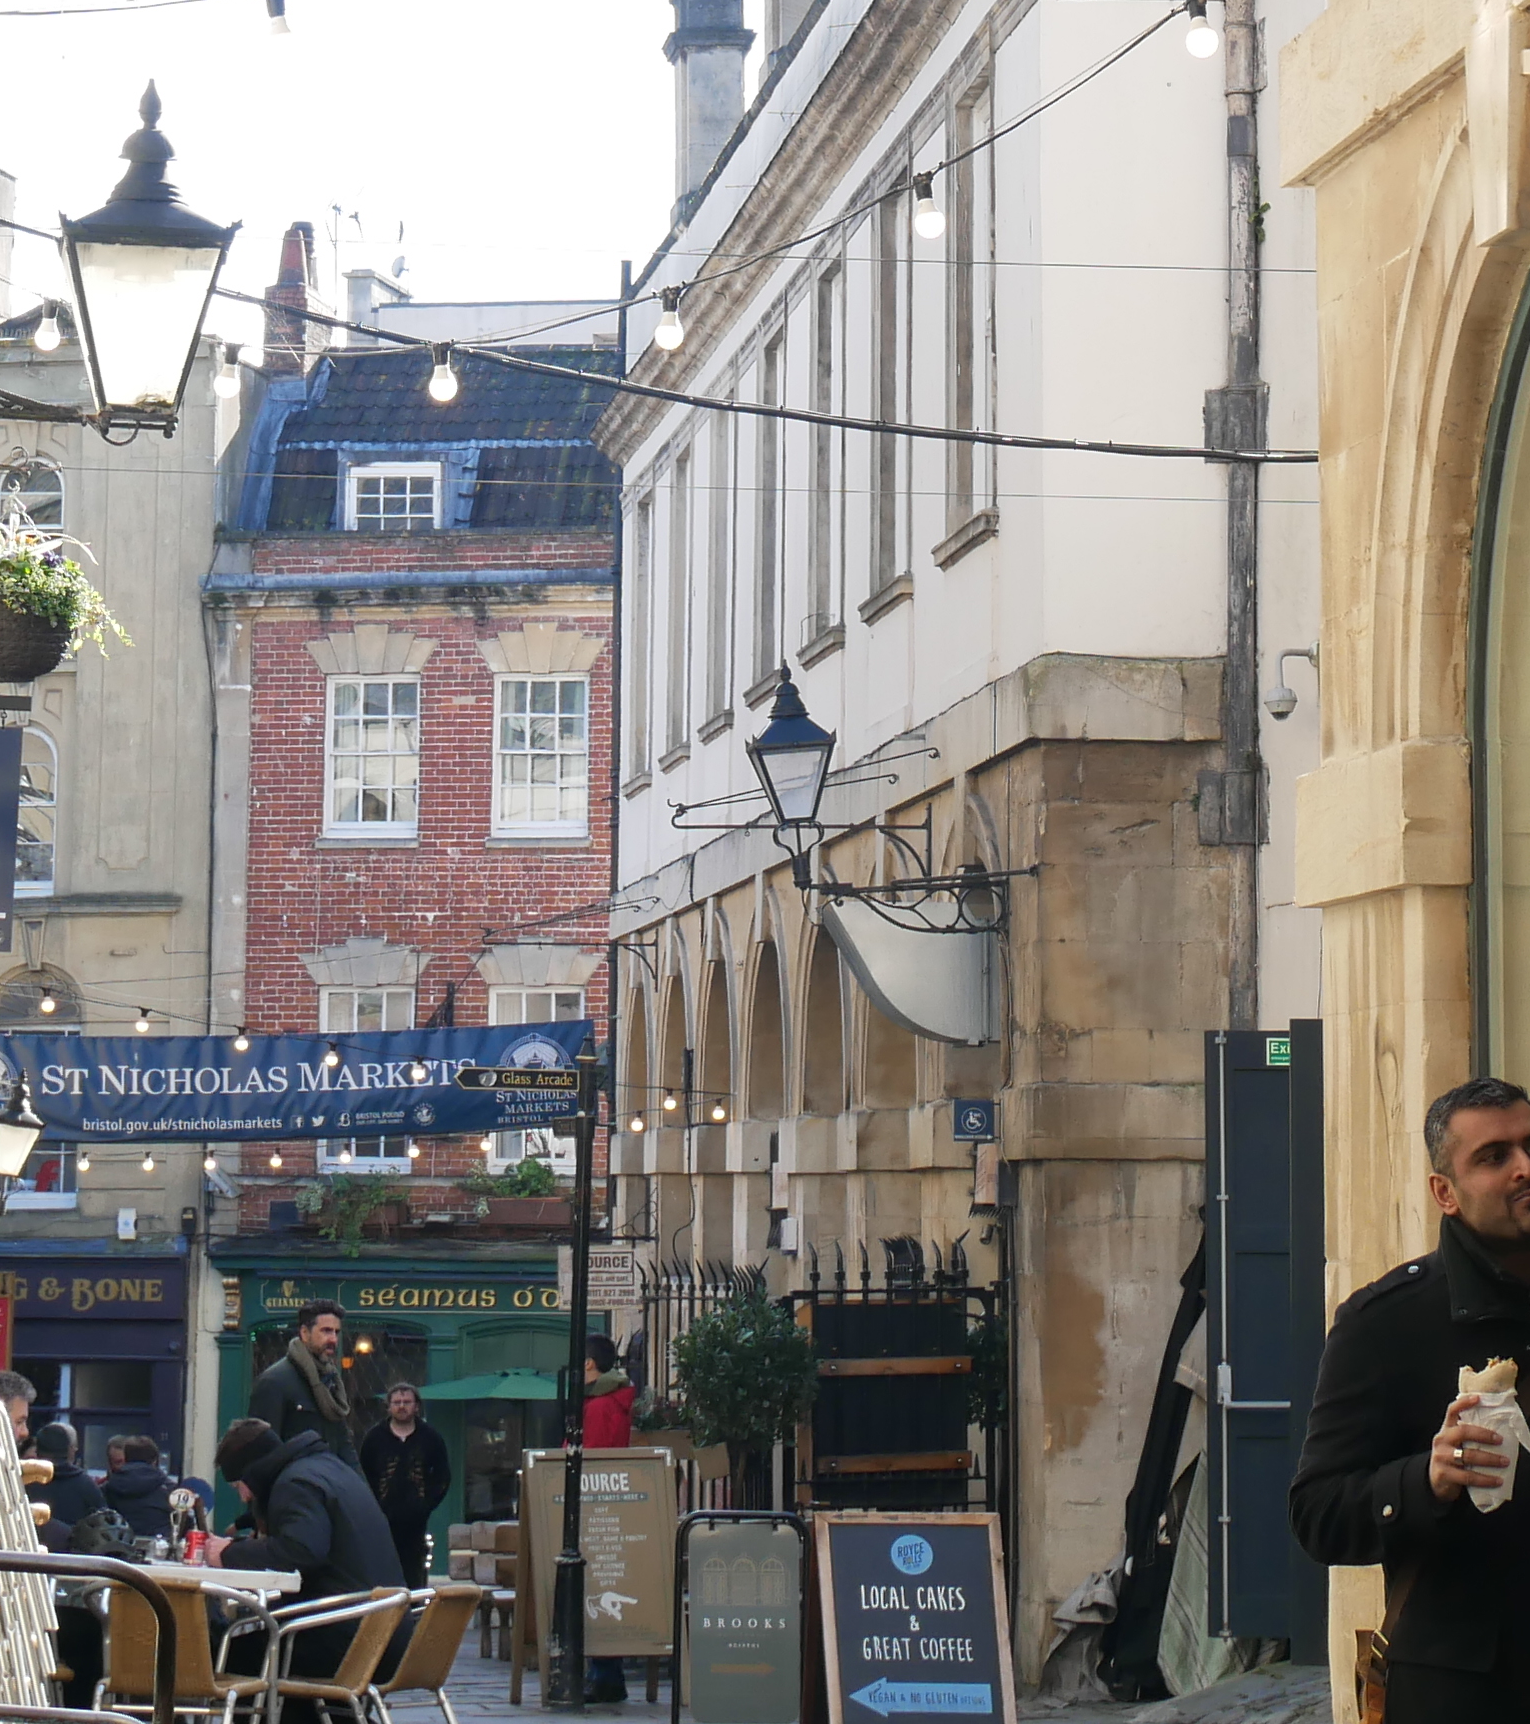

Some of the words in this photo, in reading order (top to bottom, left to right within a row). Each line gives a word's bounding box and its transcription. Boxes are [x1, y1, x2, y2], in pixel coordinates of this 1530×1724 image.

[1270, 1041, 1291, 1054] Exi
[41, 1064, 89, 1096] ST
[97, 1063, 289, 1096] NICHOLAS
[501, 1072, 531, 1085] Glass
[536, 1073, 573, 1087] Arcade
[496, 1090, 512, 1103] ST
[516, 1089, 577, 1102] NICHOLAS
[504, 1101, 570, 1115] MARKETS
[82, 1116, 283, 1134] bristol.gov.uk/stnicholasmarkets
[497, 1114, 544, 1124] BRISTOL
[588, 1255, 629, 1268] OURCE
[38, 1278, 65, 1300] &
[71, 1278, 164, 1311] BONE
[580, 1472, 630, 1493] OURCE
[177, 1493, 190, 1503] 19
[897, 1542, 925, 1558] ROYCE
[902, 1555, 923, 1566] ROLLS
[860, 1585, 910, 1611] LOCAL
[916, 1586, 967, 1611] CAKES
[702, 1617, 787, 1630] BROOKS
[910, 1615, 921, 1632] &
[862, 1635, 912, 1661] GREAT
[920, 1637, 975, 1662] COFFEE
[868, 1689, 897, 1704] VEGAN
[910, 1691, 922, 1704] NO
[925, 1691, 959, 1706] GLUTEN
